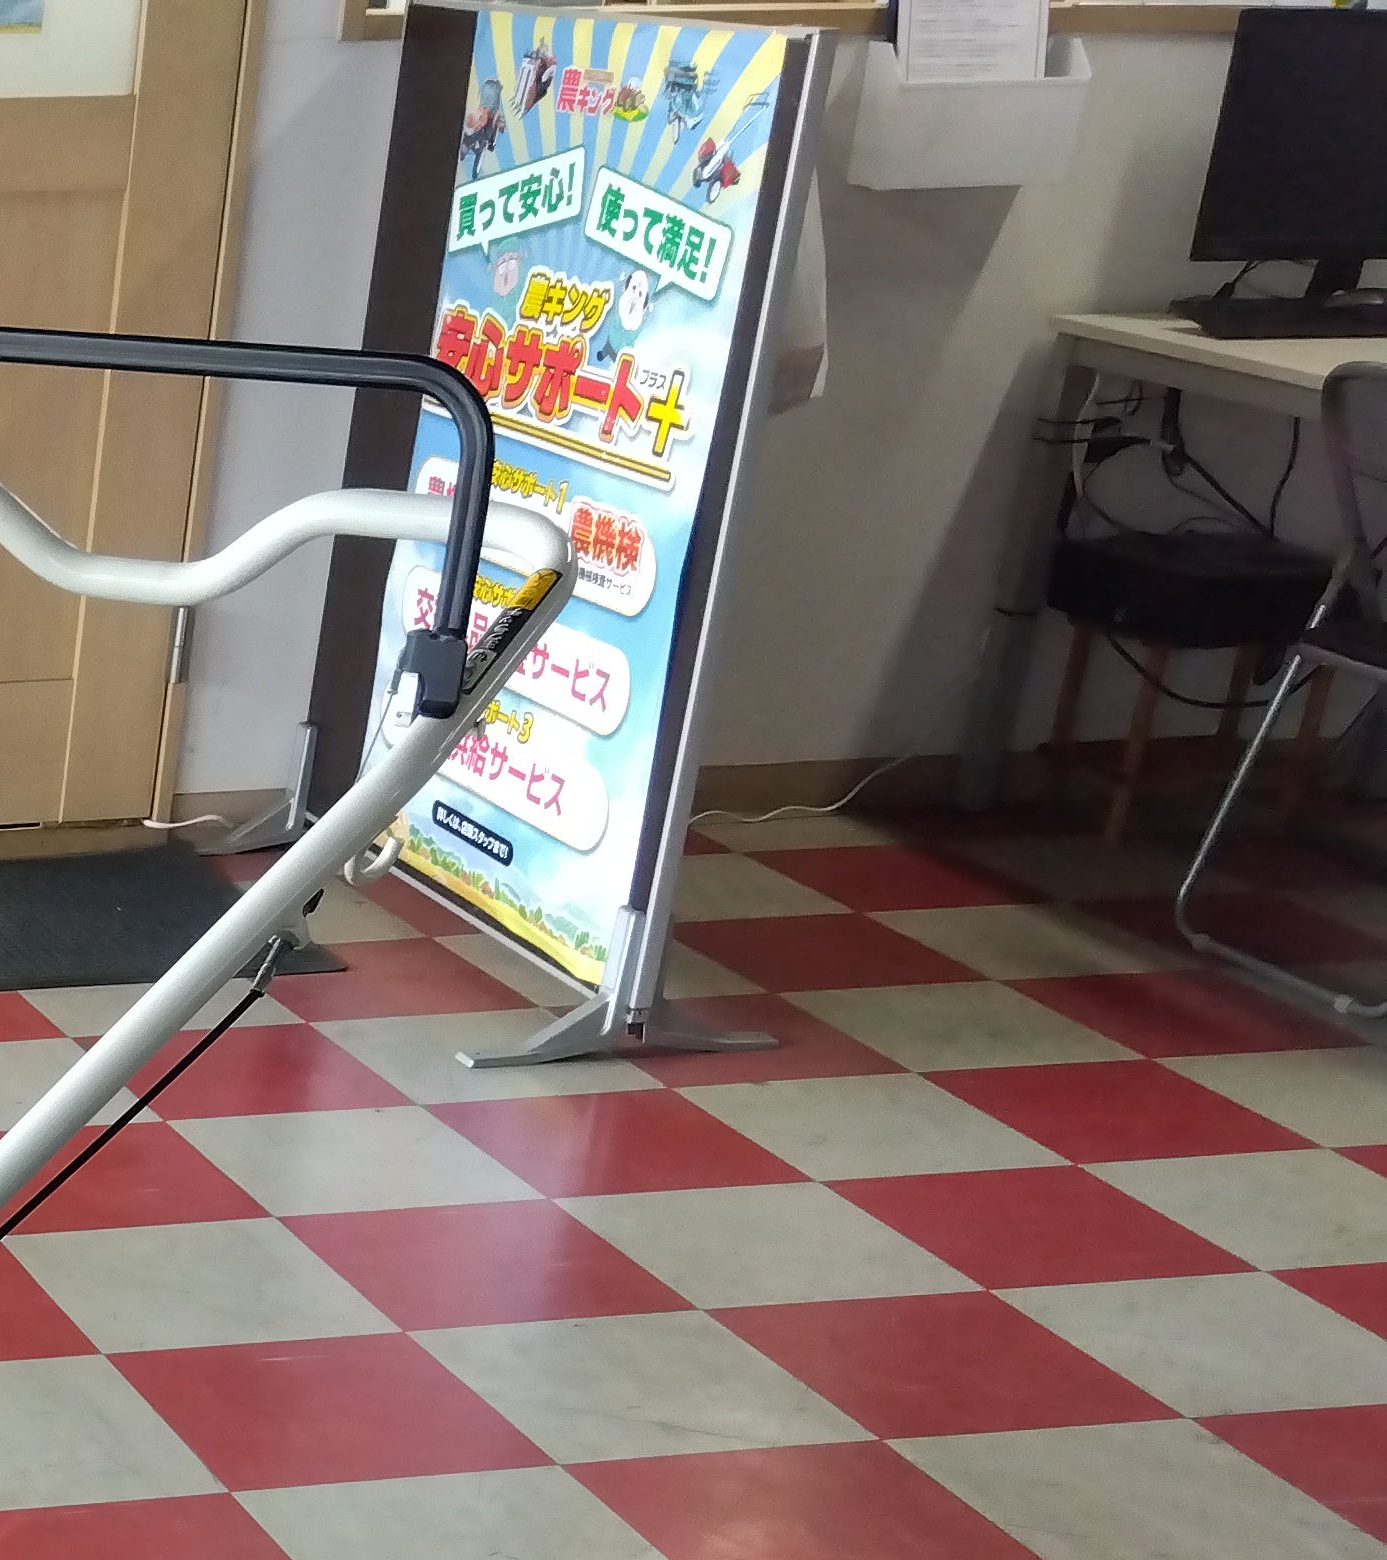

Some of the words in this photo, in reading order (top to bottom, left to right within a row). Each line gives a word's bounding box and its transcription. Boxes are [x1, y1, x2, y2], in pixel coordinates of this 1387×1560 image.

[456, 162, 576, 240] 買って安心!
[597, 183, 717, 283] 使って満足!
[640, 369, 667, 390] プラス
